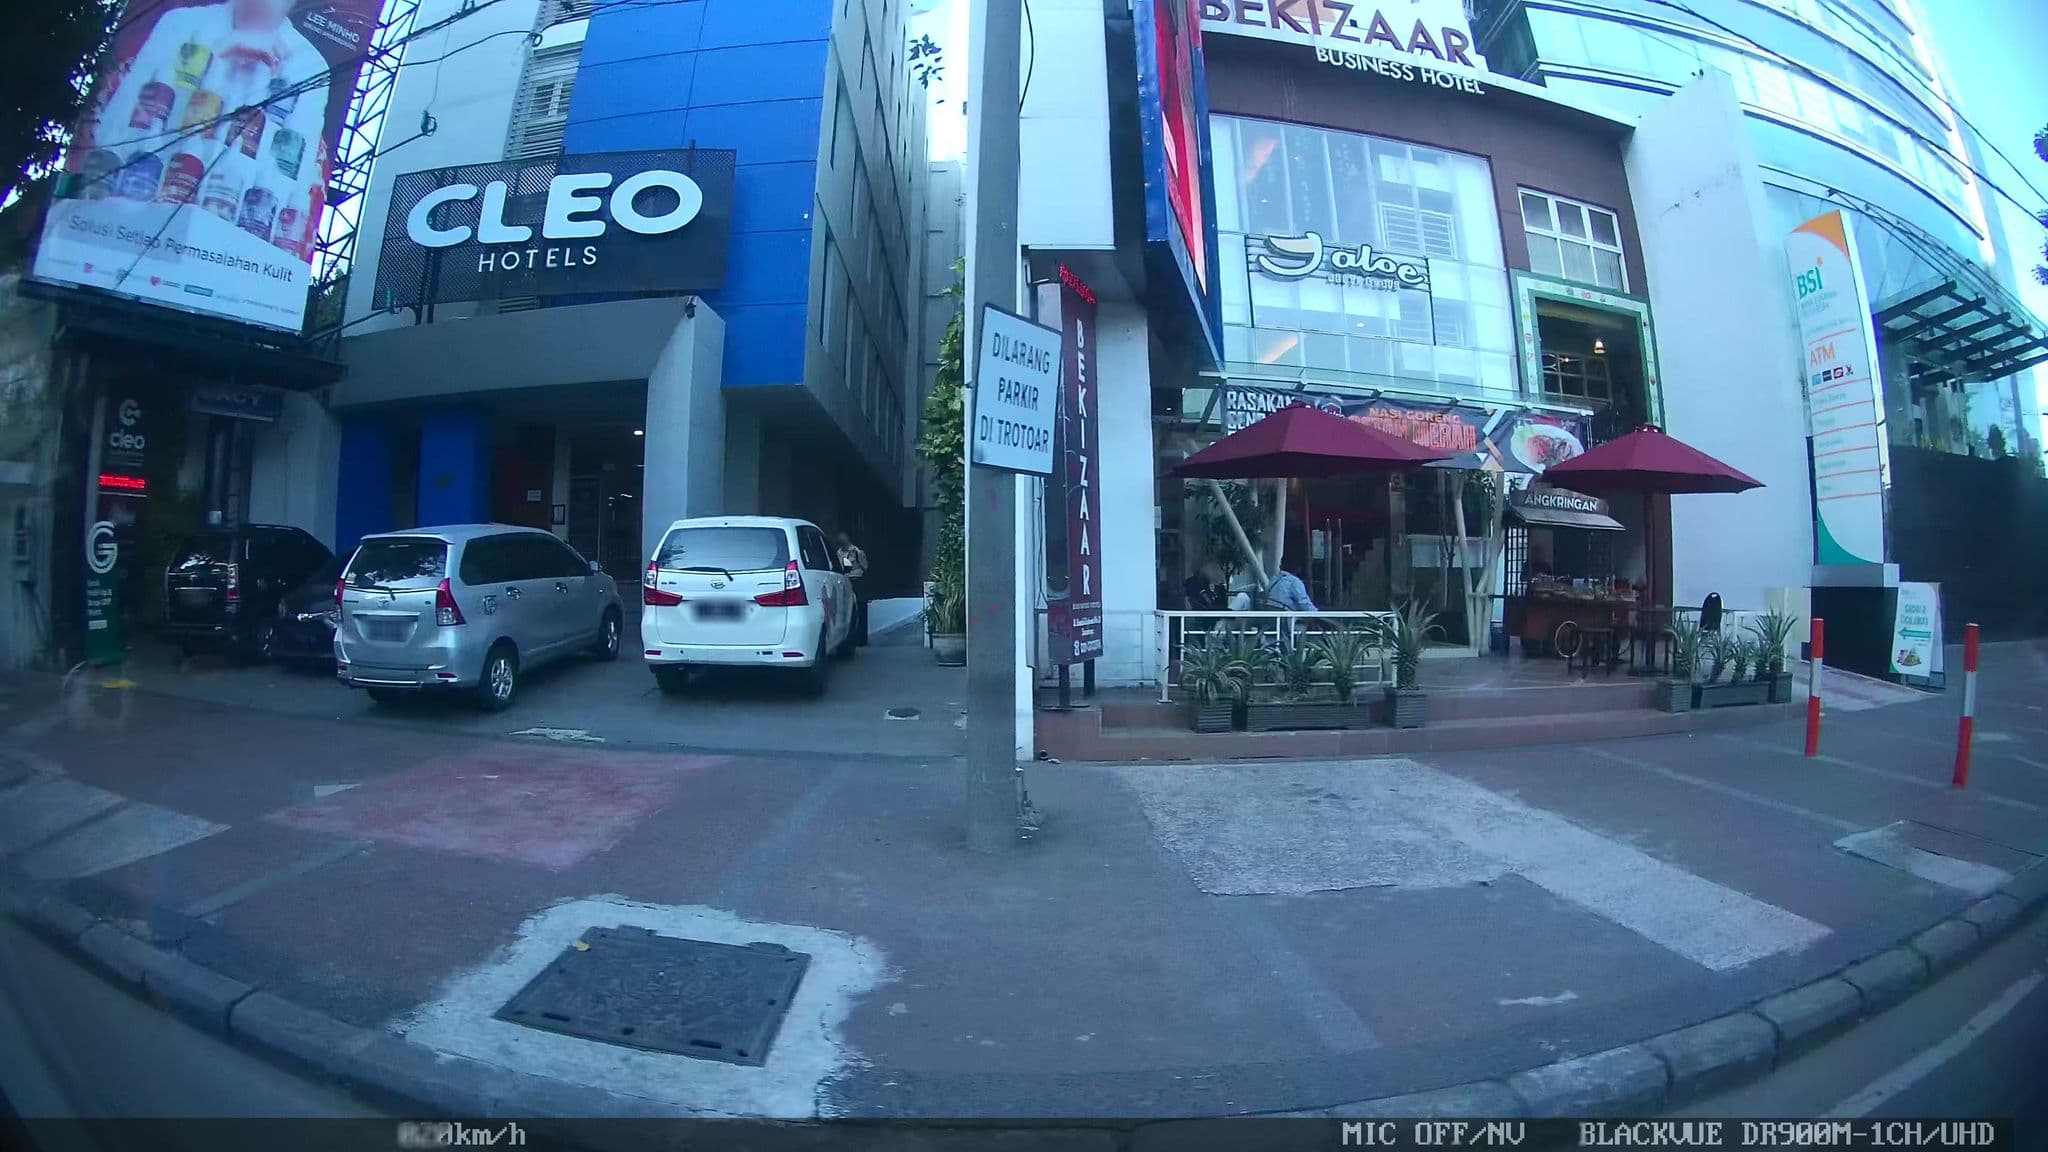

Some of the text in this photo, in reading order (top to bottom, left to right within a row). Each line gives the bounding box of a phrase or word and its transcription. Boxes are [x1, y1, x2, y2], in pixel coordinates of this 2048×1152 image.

[306, 12, 360, 43] LEE MINHO
[1315, 47, 1485, 95] BUSINESS HOTEL
[406, 169, 703, 248] CLEO
[68, 215, 294, 283] Solusi Setiap Permasalahan Kulit
[478, 246, 597, 272] HOTELS
[1796, 265, 1823, 300] BSI
[992, 332, 1050, 375] DILARANG
[1809, 342, 1836, 367] ATM
[997, 376, 1039, 412] PARKIR
[980, 414, 1050, 454] DI TROTOAR
[1407, 410, 1462, 424] GORENG
[109, 429, 145, 449] cleo
[1076, 317, 1091, 595] BEKIZAAR
[1524, 493, 1598, 512] ANGKRINGAN
